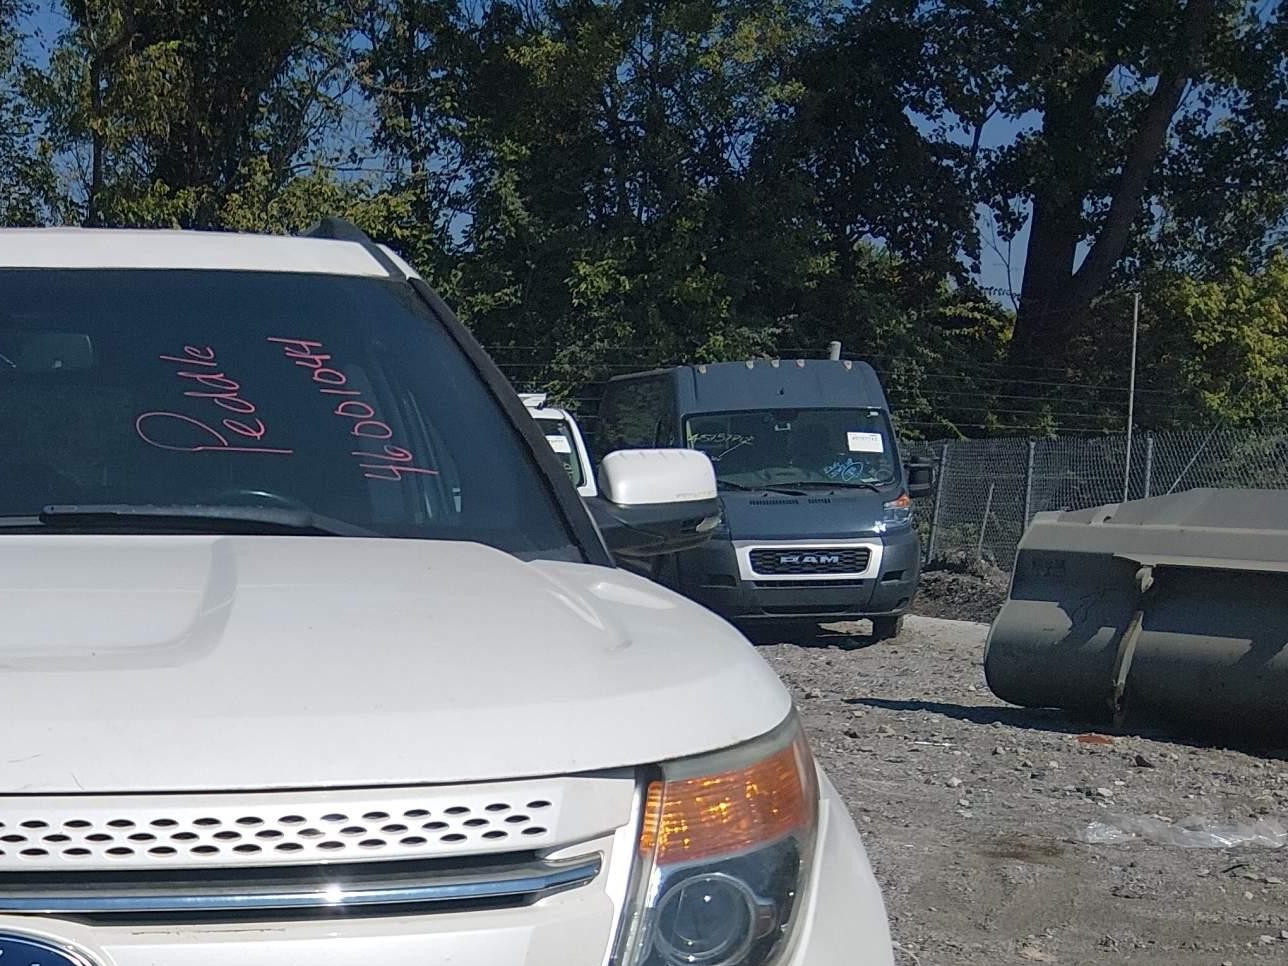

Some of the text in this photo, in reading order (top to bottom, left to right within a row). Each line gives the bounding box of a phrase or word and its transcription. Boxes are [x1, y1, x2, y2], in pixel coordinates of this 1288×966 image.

[135, 345, 294, 453] Peddle
[267, 337, 440, 481] 46001044
[779, 555, 840, 565] RAM
